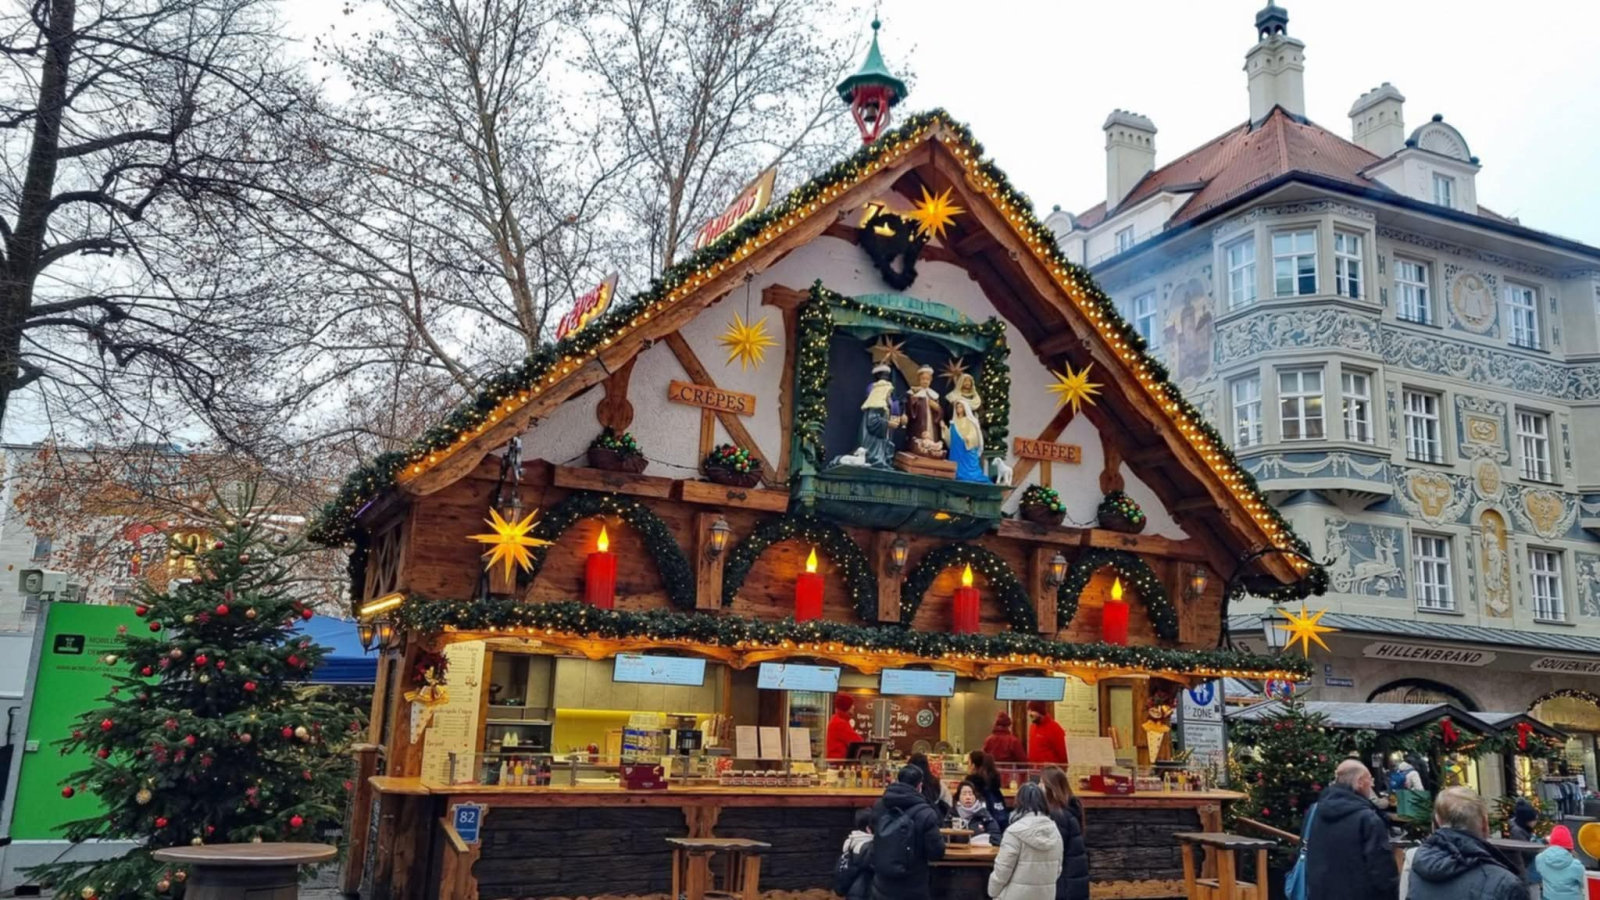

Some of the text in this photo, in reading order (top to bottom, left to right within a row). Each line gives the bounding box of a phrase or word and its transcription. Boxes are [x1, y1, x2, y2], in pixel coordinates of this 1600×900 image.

[1021, 439, 1077, 460] KAFFEE
[1376, 644, 1483, 663] HILLENBRAND
[1192, 707, 1213, 719] ZONE
[459, 811, 476, 823] 82
